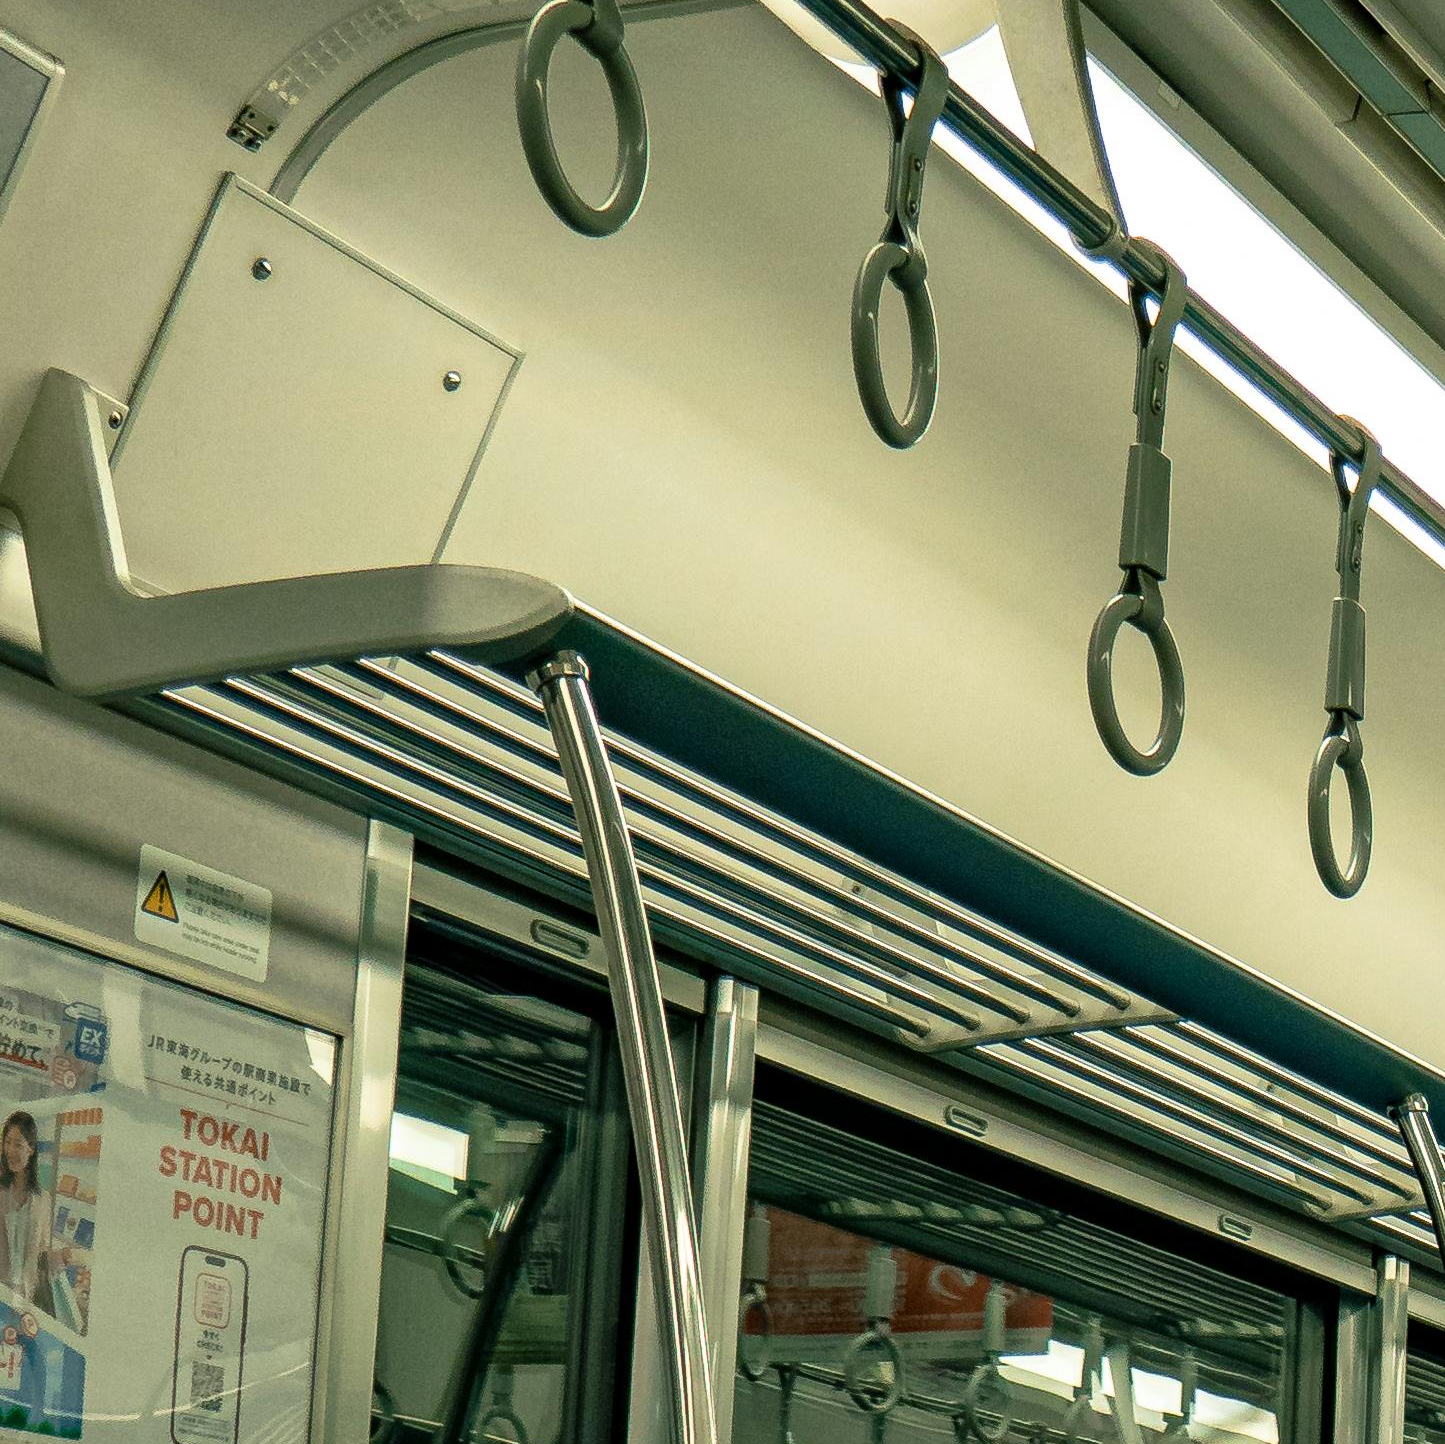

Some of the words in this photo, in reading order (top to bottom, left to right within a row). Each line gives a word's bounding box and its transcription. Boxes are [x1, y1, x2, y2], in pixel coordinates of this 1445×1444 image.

[180, 1108, 270, 1160] TOKAI
[159, 1146, 282, 1206] STATION
[173, 1189, 264, 1240] POINT
